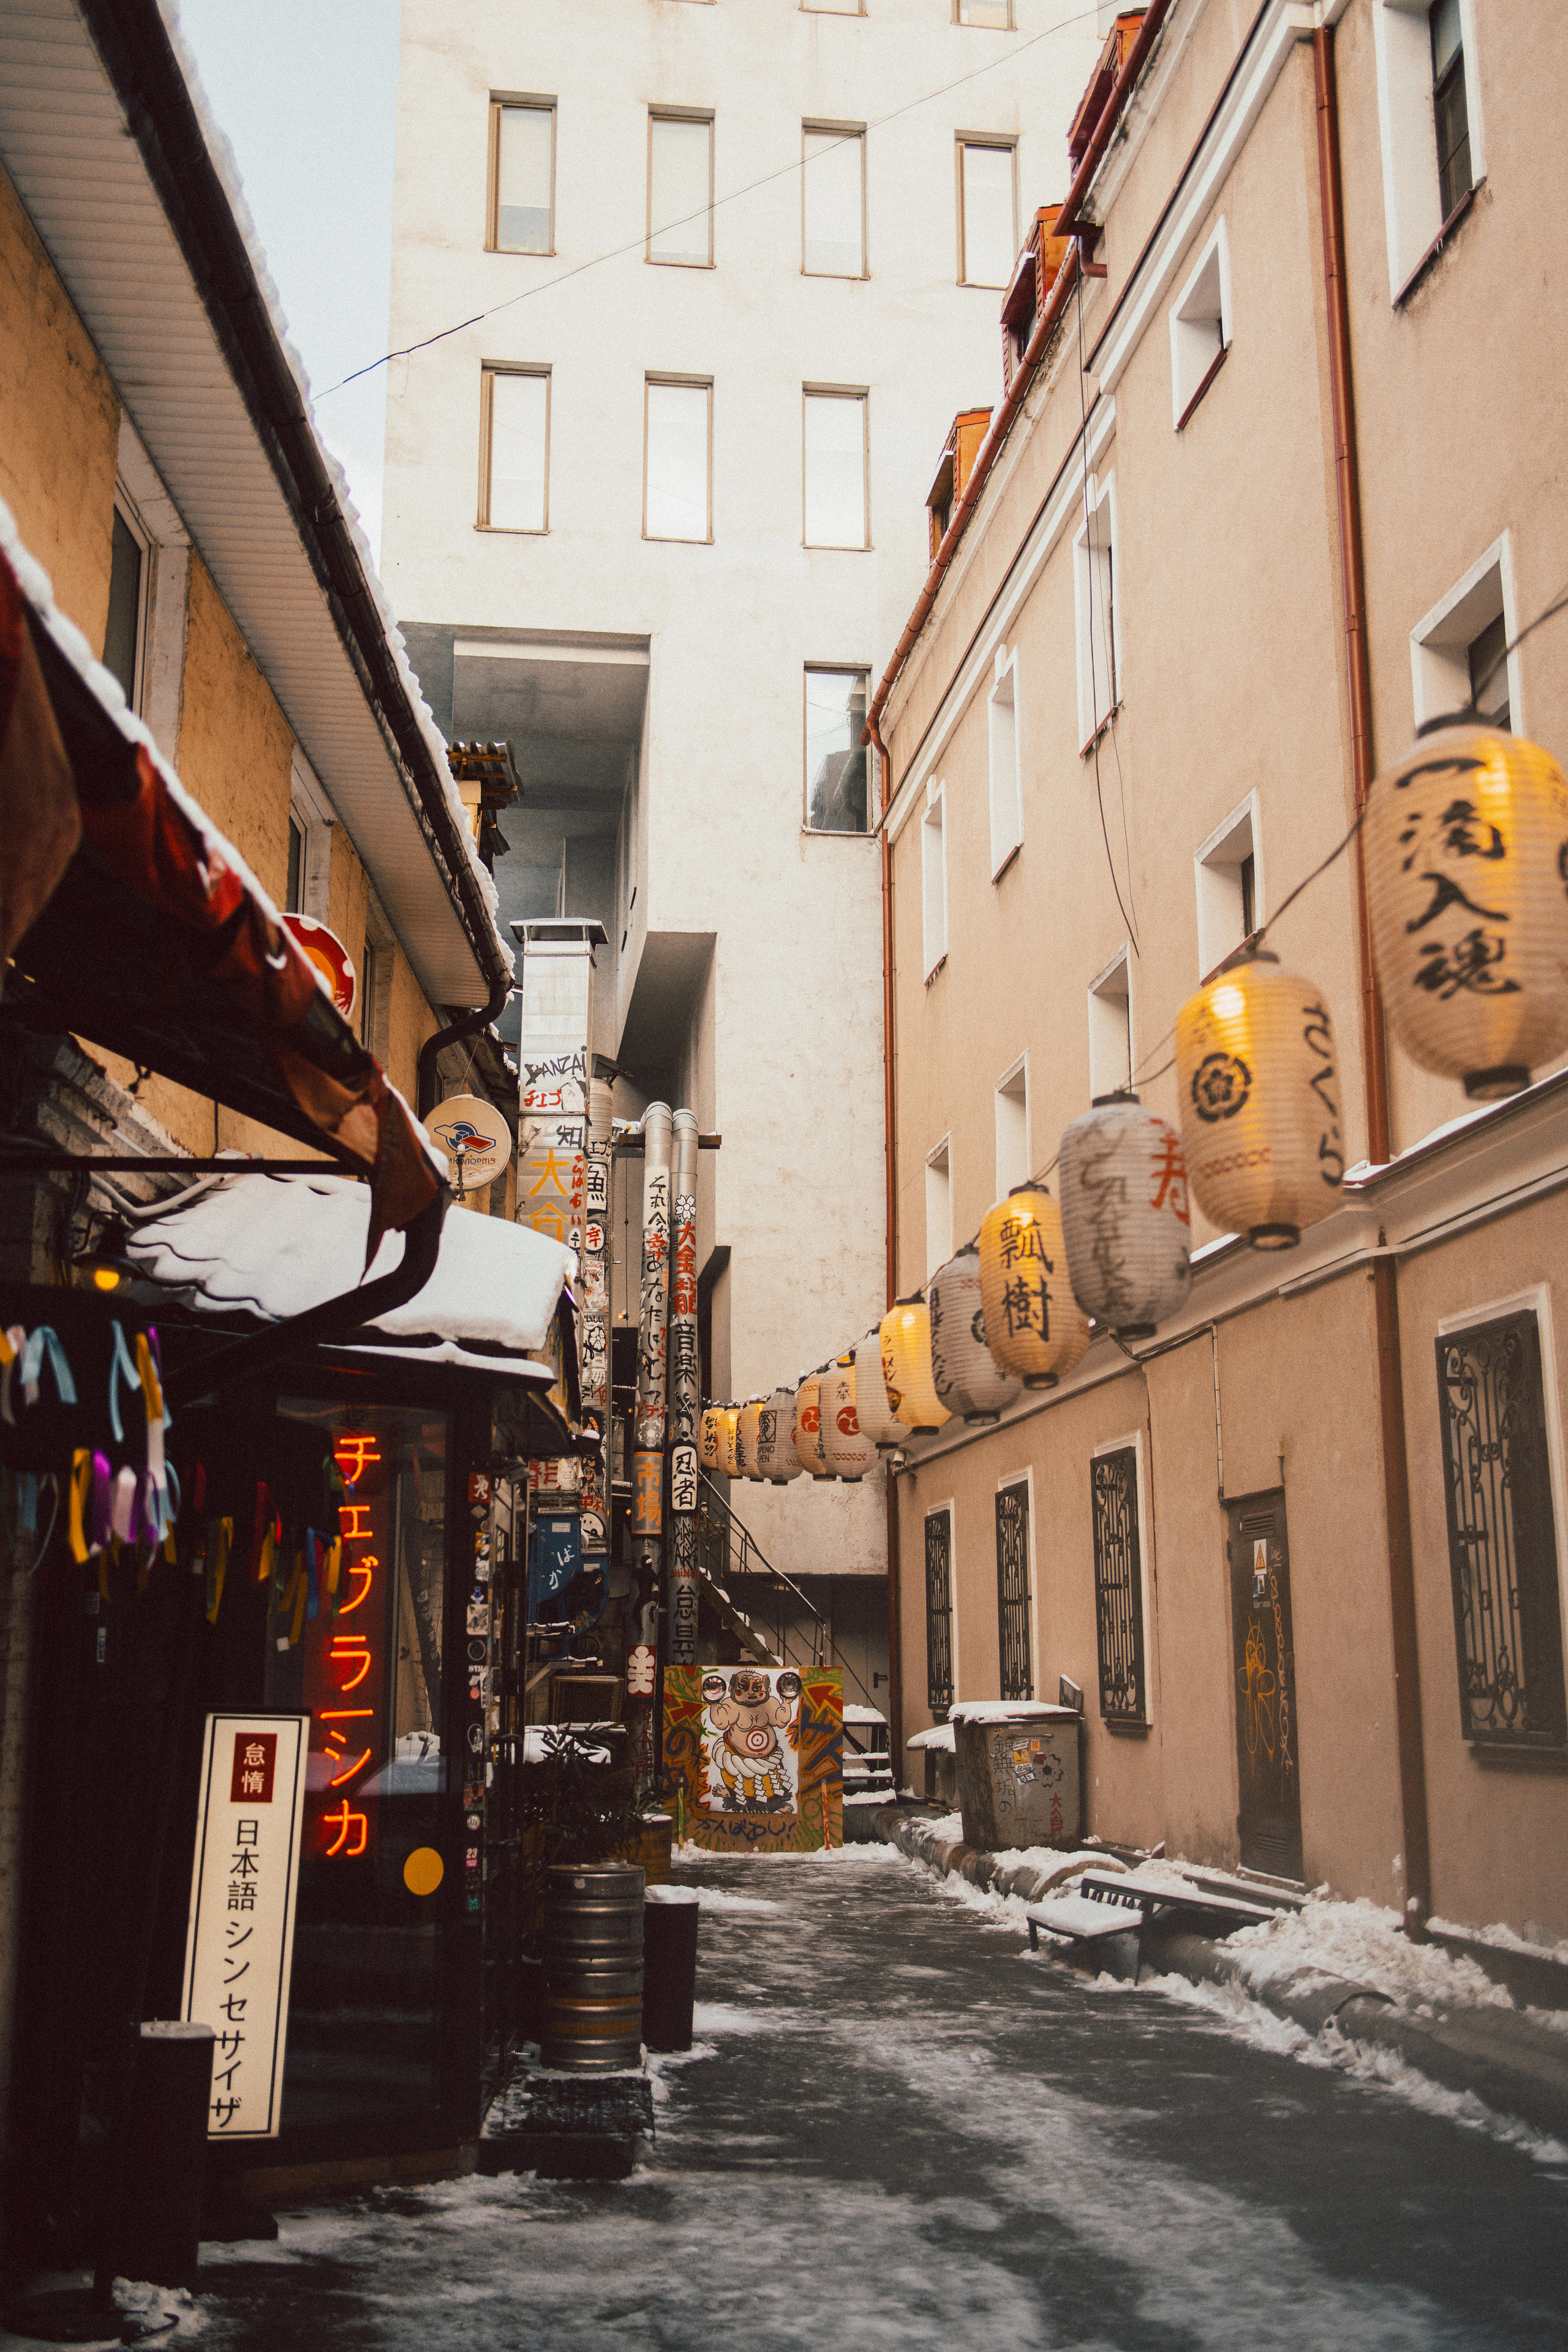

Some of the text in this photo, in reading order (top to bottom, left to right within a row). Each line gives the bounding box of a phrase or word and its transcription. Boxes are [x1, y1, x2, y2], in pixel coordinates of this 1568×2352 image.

[1303, 1002, 1345, 1186] さくら
[674, 1319, 697, 1388] 音楽
[636, 1461, 662, 1527] 市場
[673, 1452, 696, 1507] 忍者
[241, 1742, 265, 1794] 怠惰
[211, 1819, 259, 2128] 日本語シンセサイザ
